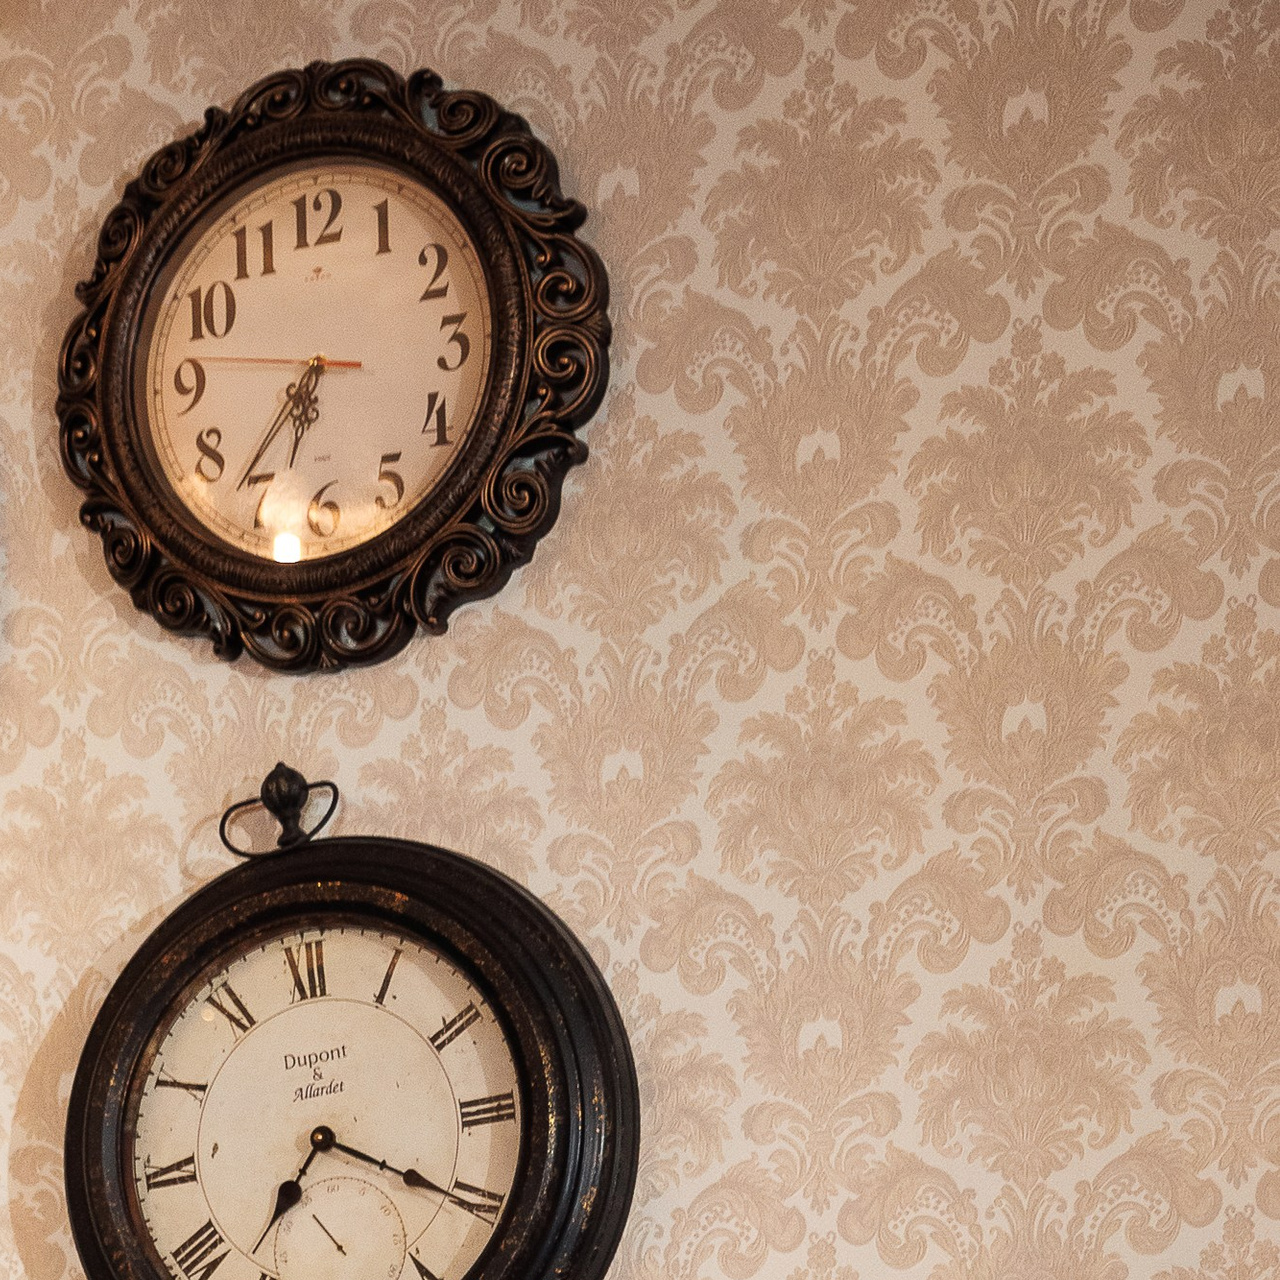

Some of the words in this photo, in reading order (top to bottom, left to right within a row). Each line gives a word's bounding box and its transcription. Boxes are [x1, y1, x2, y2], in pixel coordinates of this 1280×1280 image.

[291, 188, 343, 250] 12
[374, 198, 392, 256] 1
[233, 220, 276, 280] 11
[418, 243, 449, 302] 2
[188, 280, 236, 341] 10
[436, 312, 471, 371] 3
[174, 357, 206, 416] 9
[421, 391, 454, 447] 4
[194, 427, 225, 483] 8
[374, 451, 405, 510] 5
[247, 472, 276, 529] 7
[307, 479, 341, 537] 6
[283, 940, 332, 1004] XII
[374, 948, 403, 1009] I
[205, 979, 257, 1043] XI
[428, 1002, 484, 1054] II
[154, 1063, 208, 1108] X
[283, 1045, 348, 1071] Dupont
[312, 1066, 324, 1081] &
[293, 1080, 345, 1102] Allardet
[458, 1088, 516, 1132] III
[145, 1152, 198, 1192] IX
